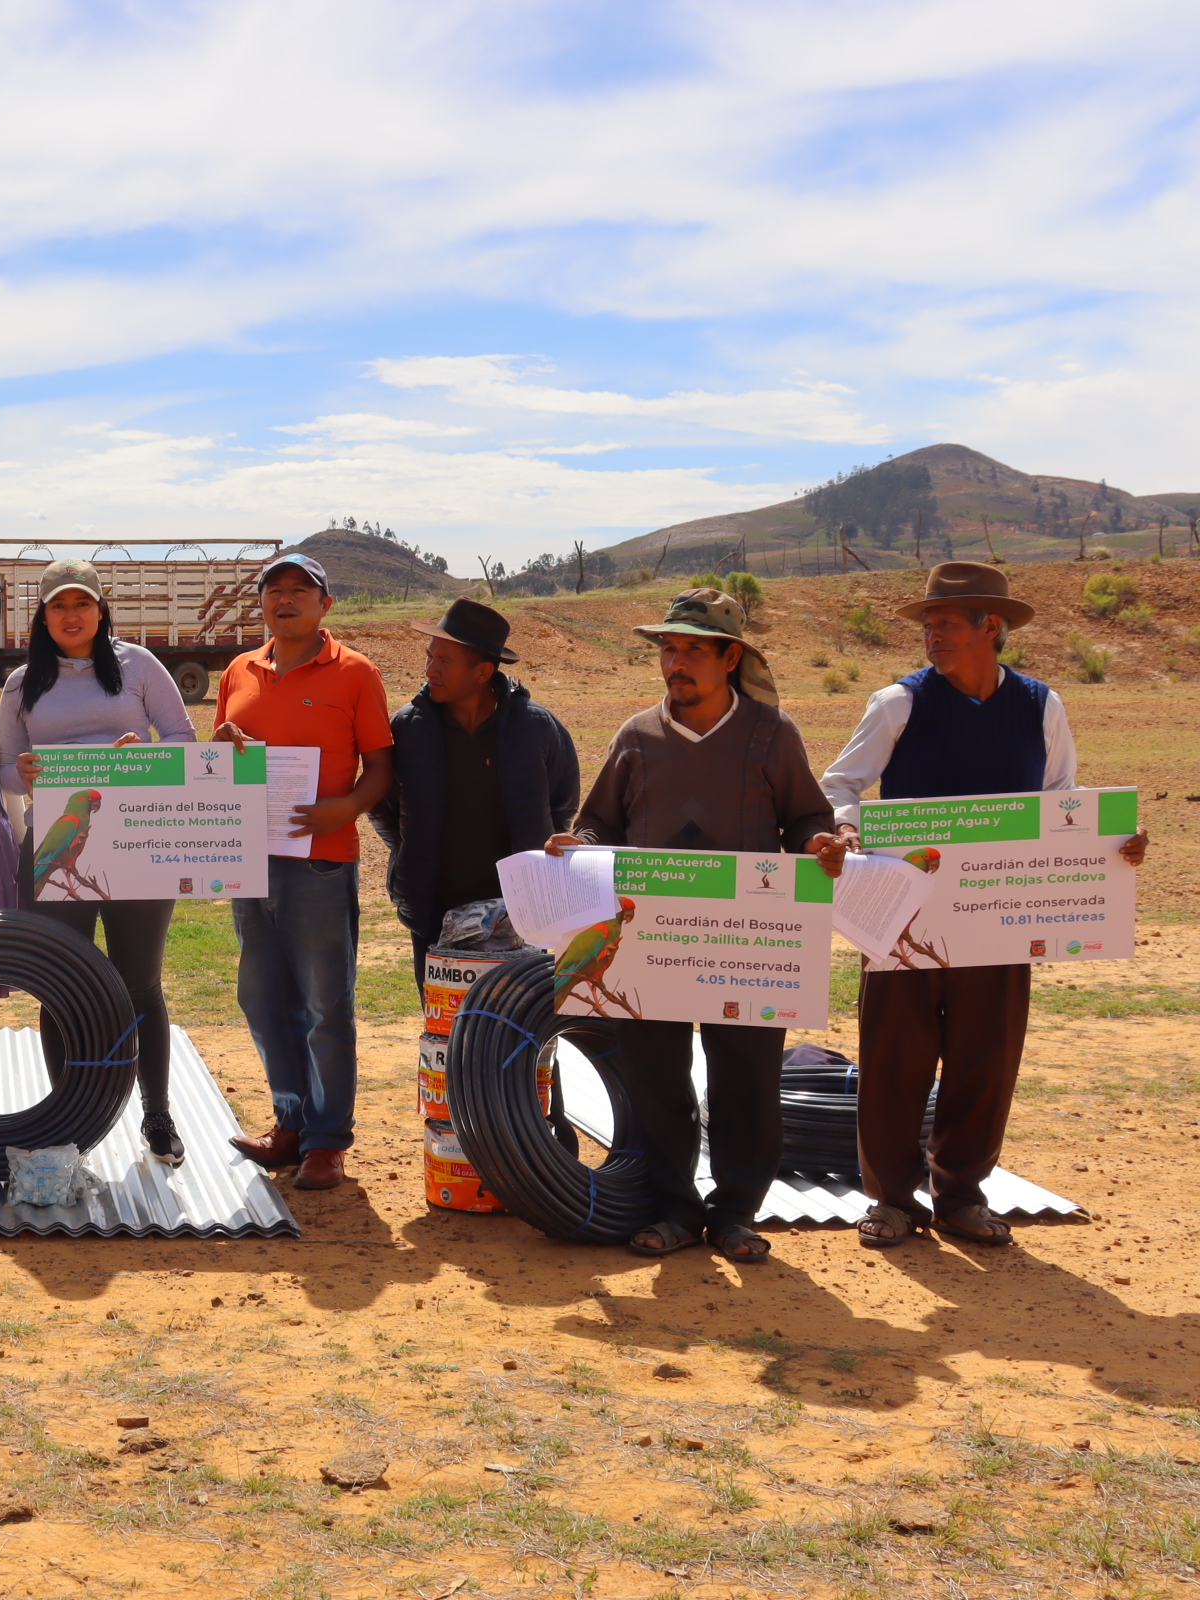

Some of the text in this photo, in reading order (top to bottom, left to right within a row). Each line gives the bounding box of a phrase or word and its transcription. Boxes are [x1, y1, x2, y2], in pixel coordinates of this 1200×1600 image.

[77, 752, 106, 760] firmó
[126, 751, 172, 759] Acuerdo
[36, 764, 90, 774] ecíproco
[93, 765, 111, 773] por
[114, 764, 142, 773] Agua
[36, 775, 110, 785] Biodiversidad
[119, 802, 241, 813] Guardián del Bosque
[863, 808, 893, 820] Aquí
[913, 806, 946, 815] firmó
[970, 801, 1025, 812] Acuerdo
[124, 816, 242, 827] Benedicto Montaño
[864, 818, 1000, 832] Recíproco por Agua y
[113, 838, 242, 851] Superficie conservada
[864, 831, 951, 845] Biodiversidad
[150, 853, 242, 863] 12.44 hectáreas
[646, 857, 721, 868] un Acuerdo
[961, 857, 1106, 871] Guardián del Bosque
[626, 870, 648, 879] por
[652, 870, 685, 881] Agua
[689, 873, 696, 882] y
[960, 872, 1106, 889] Roger Rojas Cordova
[953, 895, 1105, 913] Superficie conservada
[656, 915, 802, 933] Guardián del Bosque
[1000, 912, 1105, 925] 10.81 hectáreas
[637, 931, 802, 948] Santiago Jaillita Alanes
[647, 955, 800, 972] Superficie conservada
[428, 965, 477, 984] RAMBO
[696, 974, 800, 989] 4.05 hectáreas
